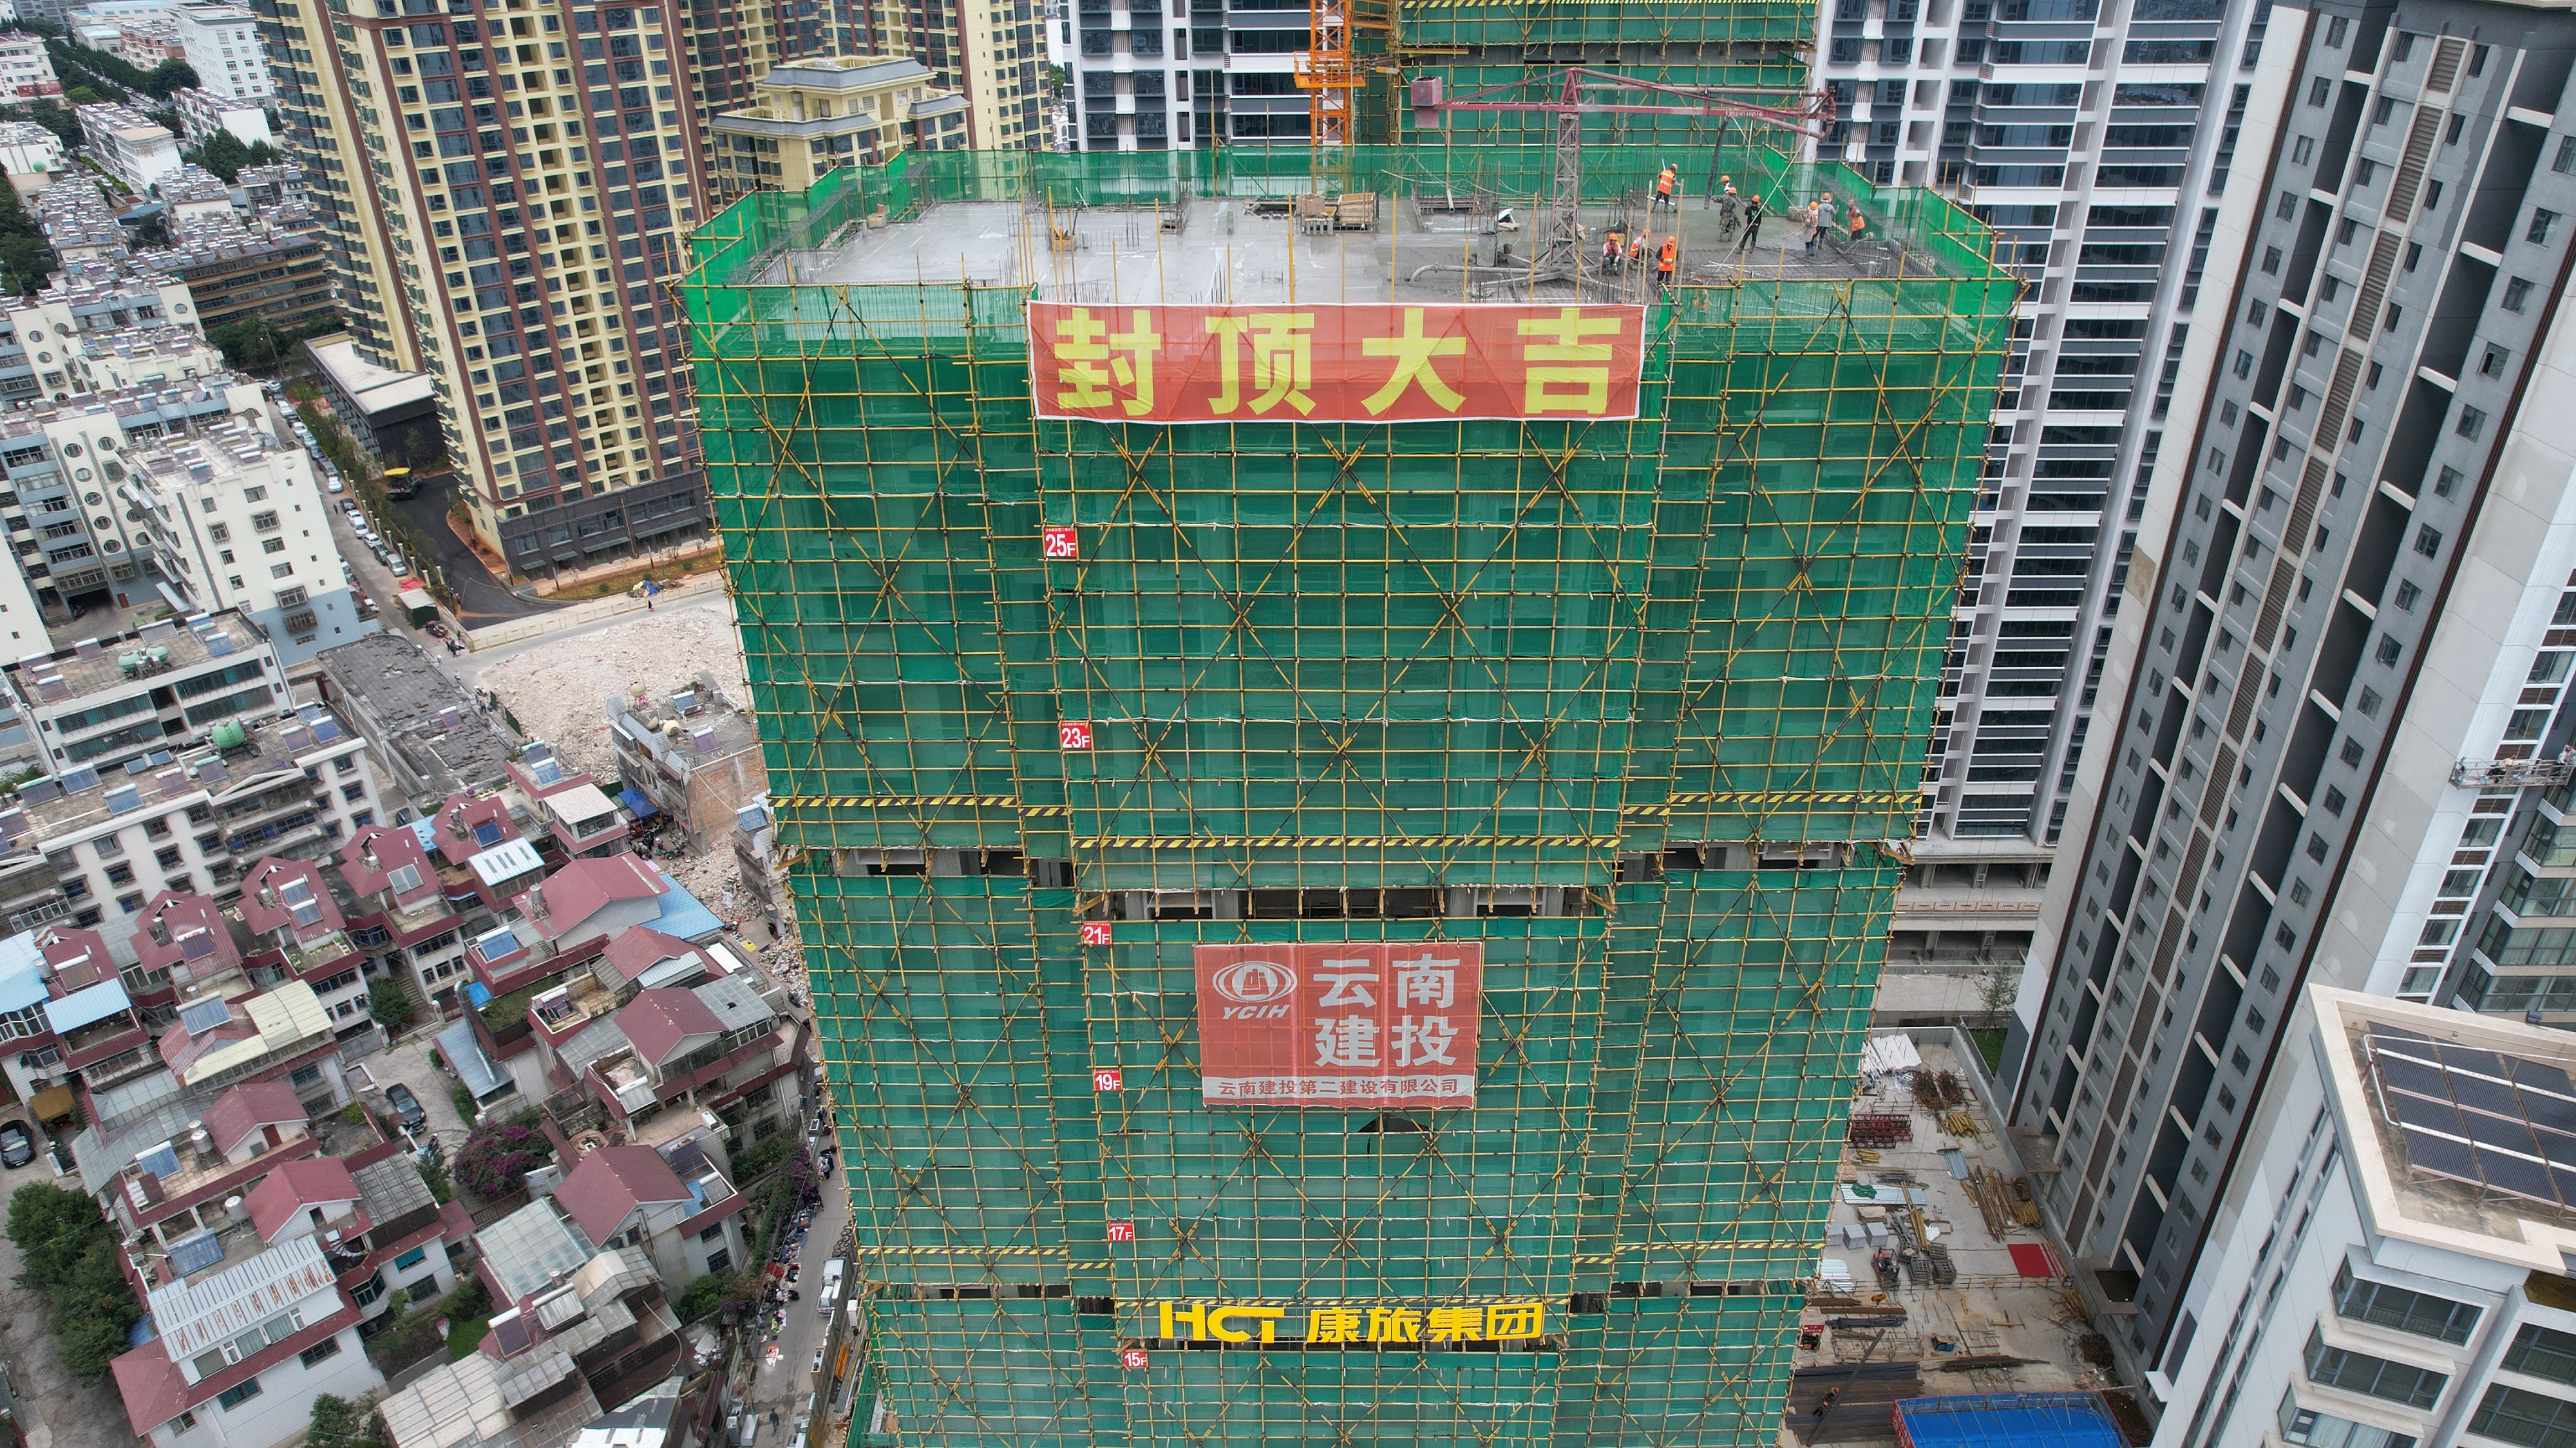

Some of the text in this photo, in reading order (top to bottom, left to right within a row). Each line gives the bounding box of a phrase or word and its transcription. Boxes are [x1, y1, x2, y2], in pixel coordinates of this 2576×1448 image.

[1054, 306, 1622, 416] 封顶大吉
[1045, 534, 1076, 557] 25F
[1061, 728, 1090, 748] 23F
[1083, 926, 1110, 945] 21F
[1313, 953, 1461, 1009] 云南
[1222, 1004, 1290, 1020] YCIH
[1314, 1015, 1458, 1067] 建投
[1095, 1073, 1121, 1091] 19F
[1217, 1078, 1458, 1096] 云南建投第二建设有限公司
[1109, 1227, 1133, 1241] 17F
[1159, 1302, 1544, 1344] HCT 康旅集团
[1124, 1352, 1147, 1367] 15F
